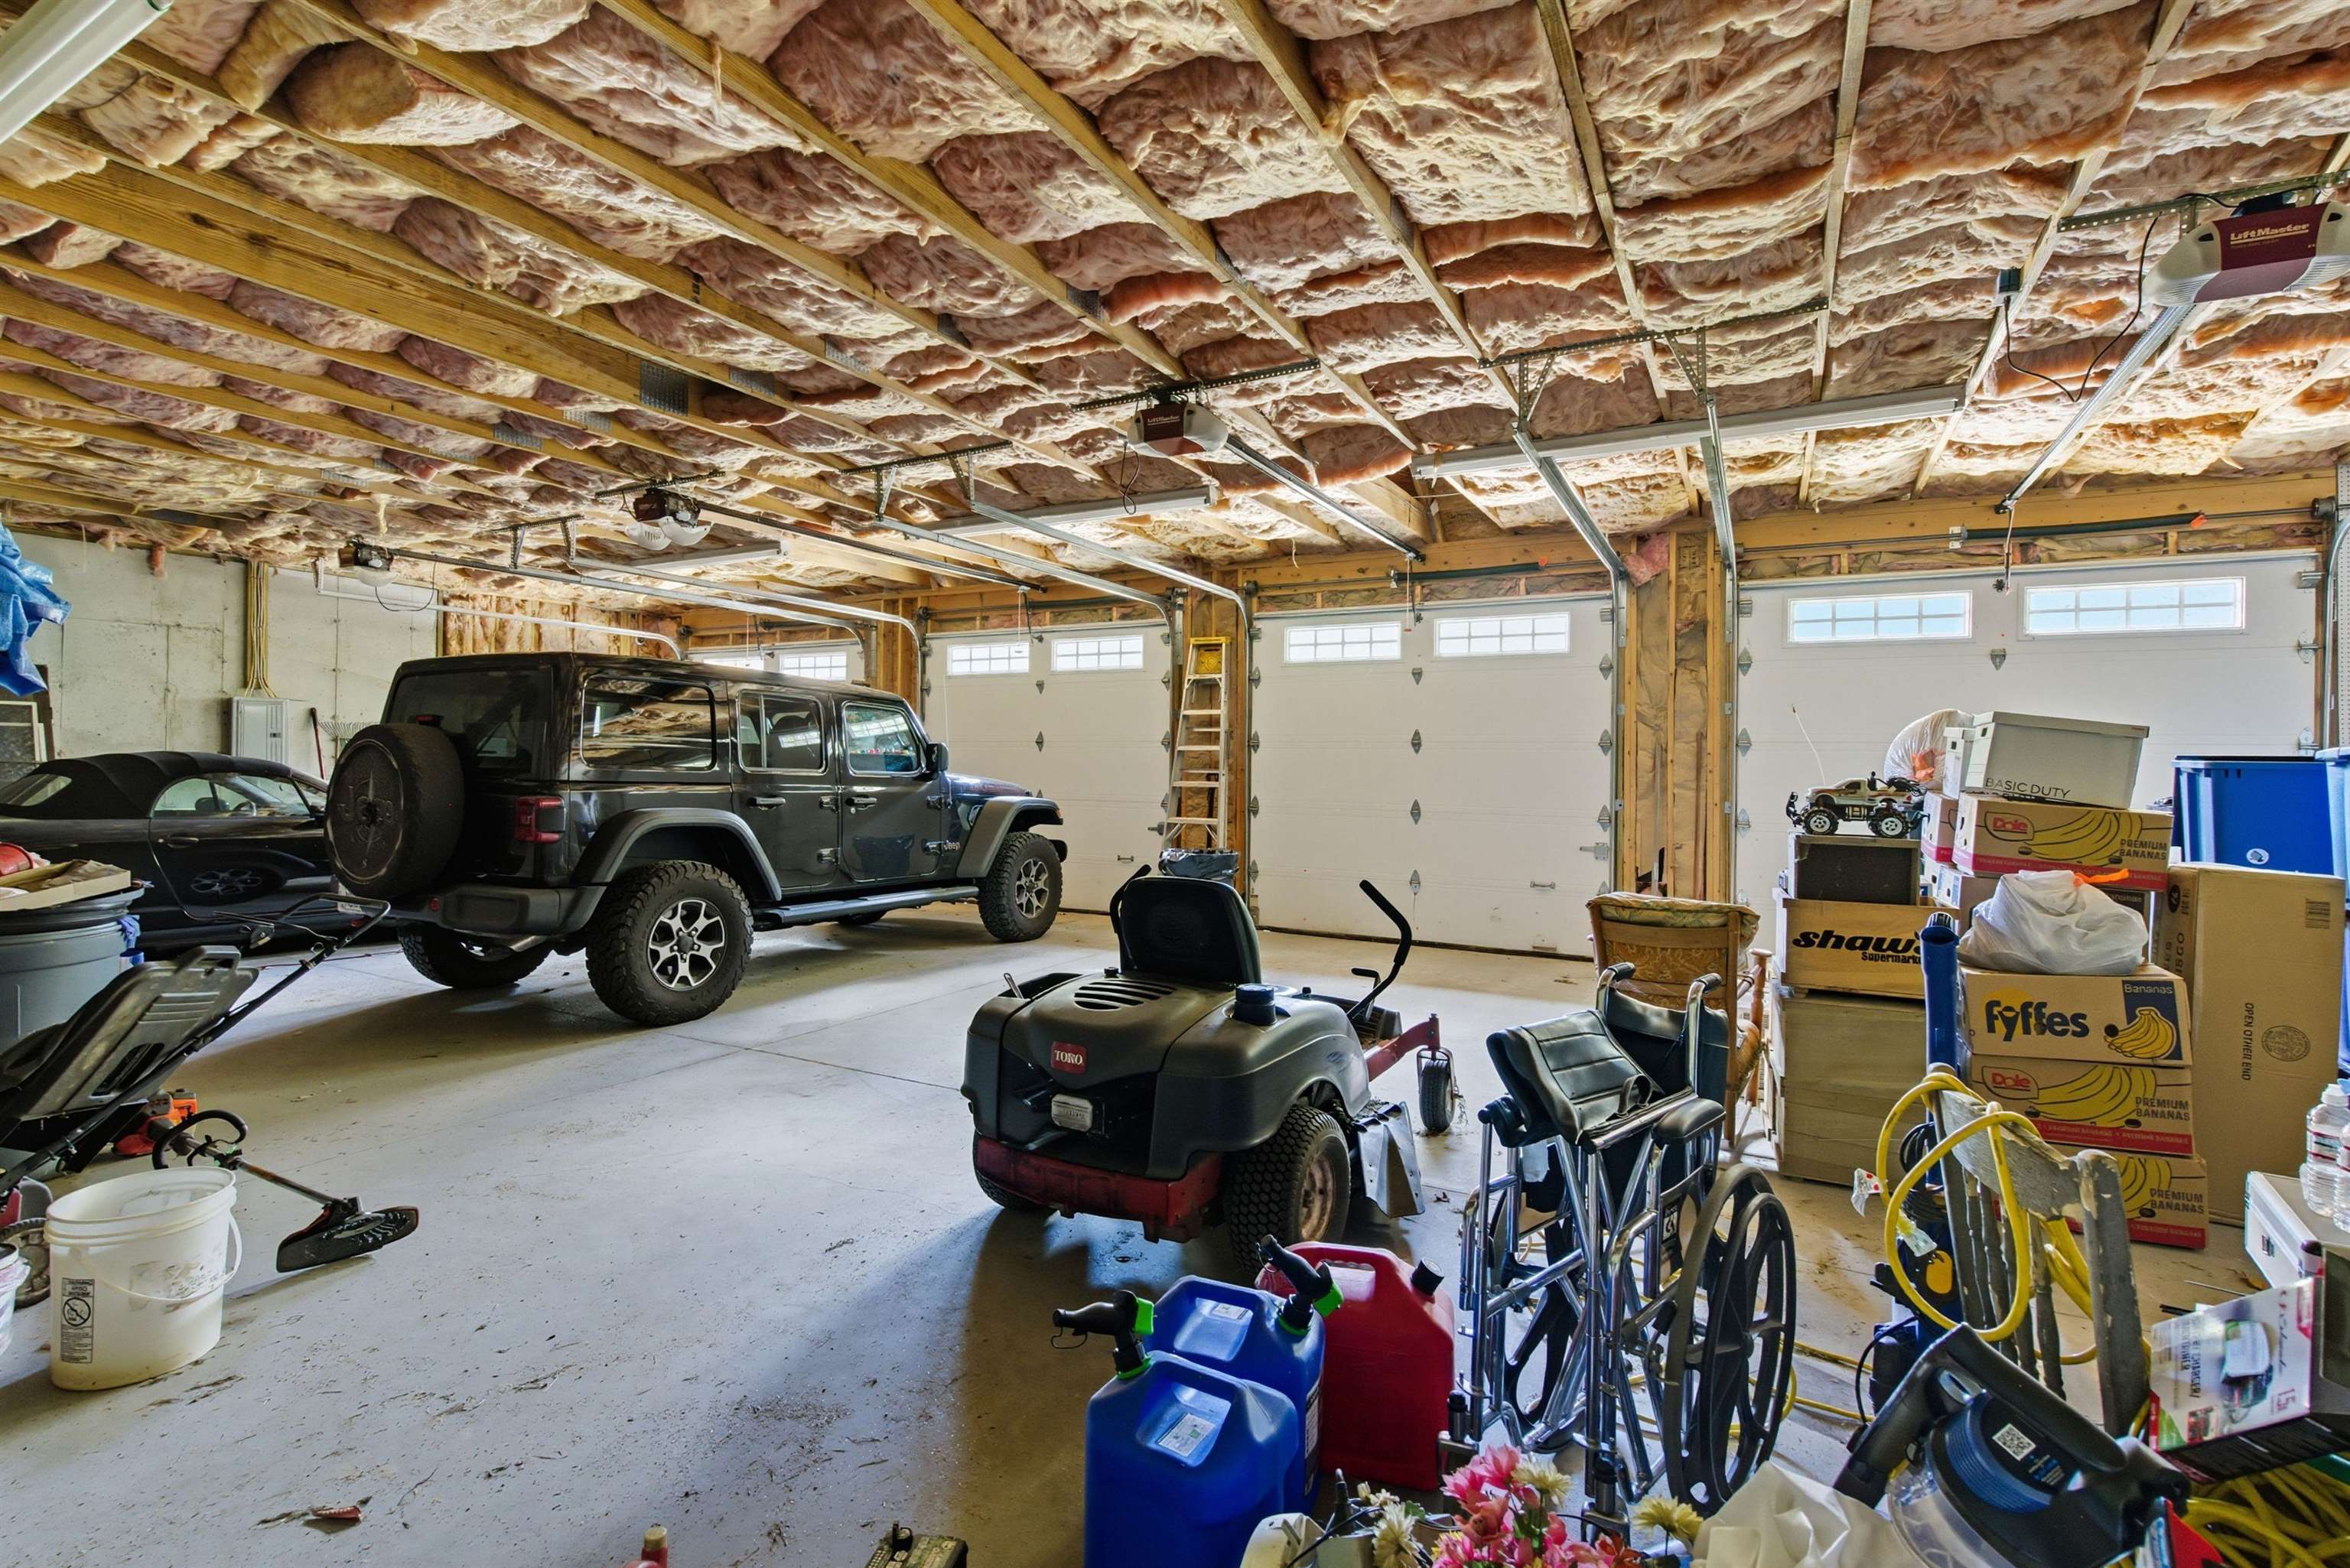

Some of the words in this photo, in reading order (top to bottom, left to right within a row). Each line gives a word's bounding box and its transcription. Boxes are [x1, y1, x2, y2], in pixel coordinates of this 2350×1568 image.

[2230, 223, 2309, 241] LiftMaster
[1984, 777, 2028, 792] BASIC
[2030, 783, 2071, 799] DUTY
[1992, 816, 2028, 831] Dole
[2120, 838, 2168, 851] PREMIUM
[2119, 848, 2167, 860] BANANAS
[2124, 984, 2173, 994] Bananas
[2244, 1003, 2254, 1028] OPEN
[2242, 1030, 2253, 1060] OTHER
[1054, 1050, 1084, 1065] TORO
[2242, 1062, 2252, 1081] END
[1991, 1072, 2031, 1088] Dole
[2135, 1096, 2189, 1110] PREMIUM
[2135, 1108, 2191, 1121] BANANAS
[2150, 1188, 2203, 1203] PREMIUM
[2150, 1199, 2204, 1214] BANANAS
